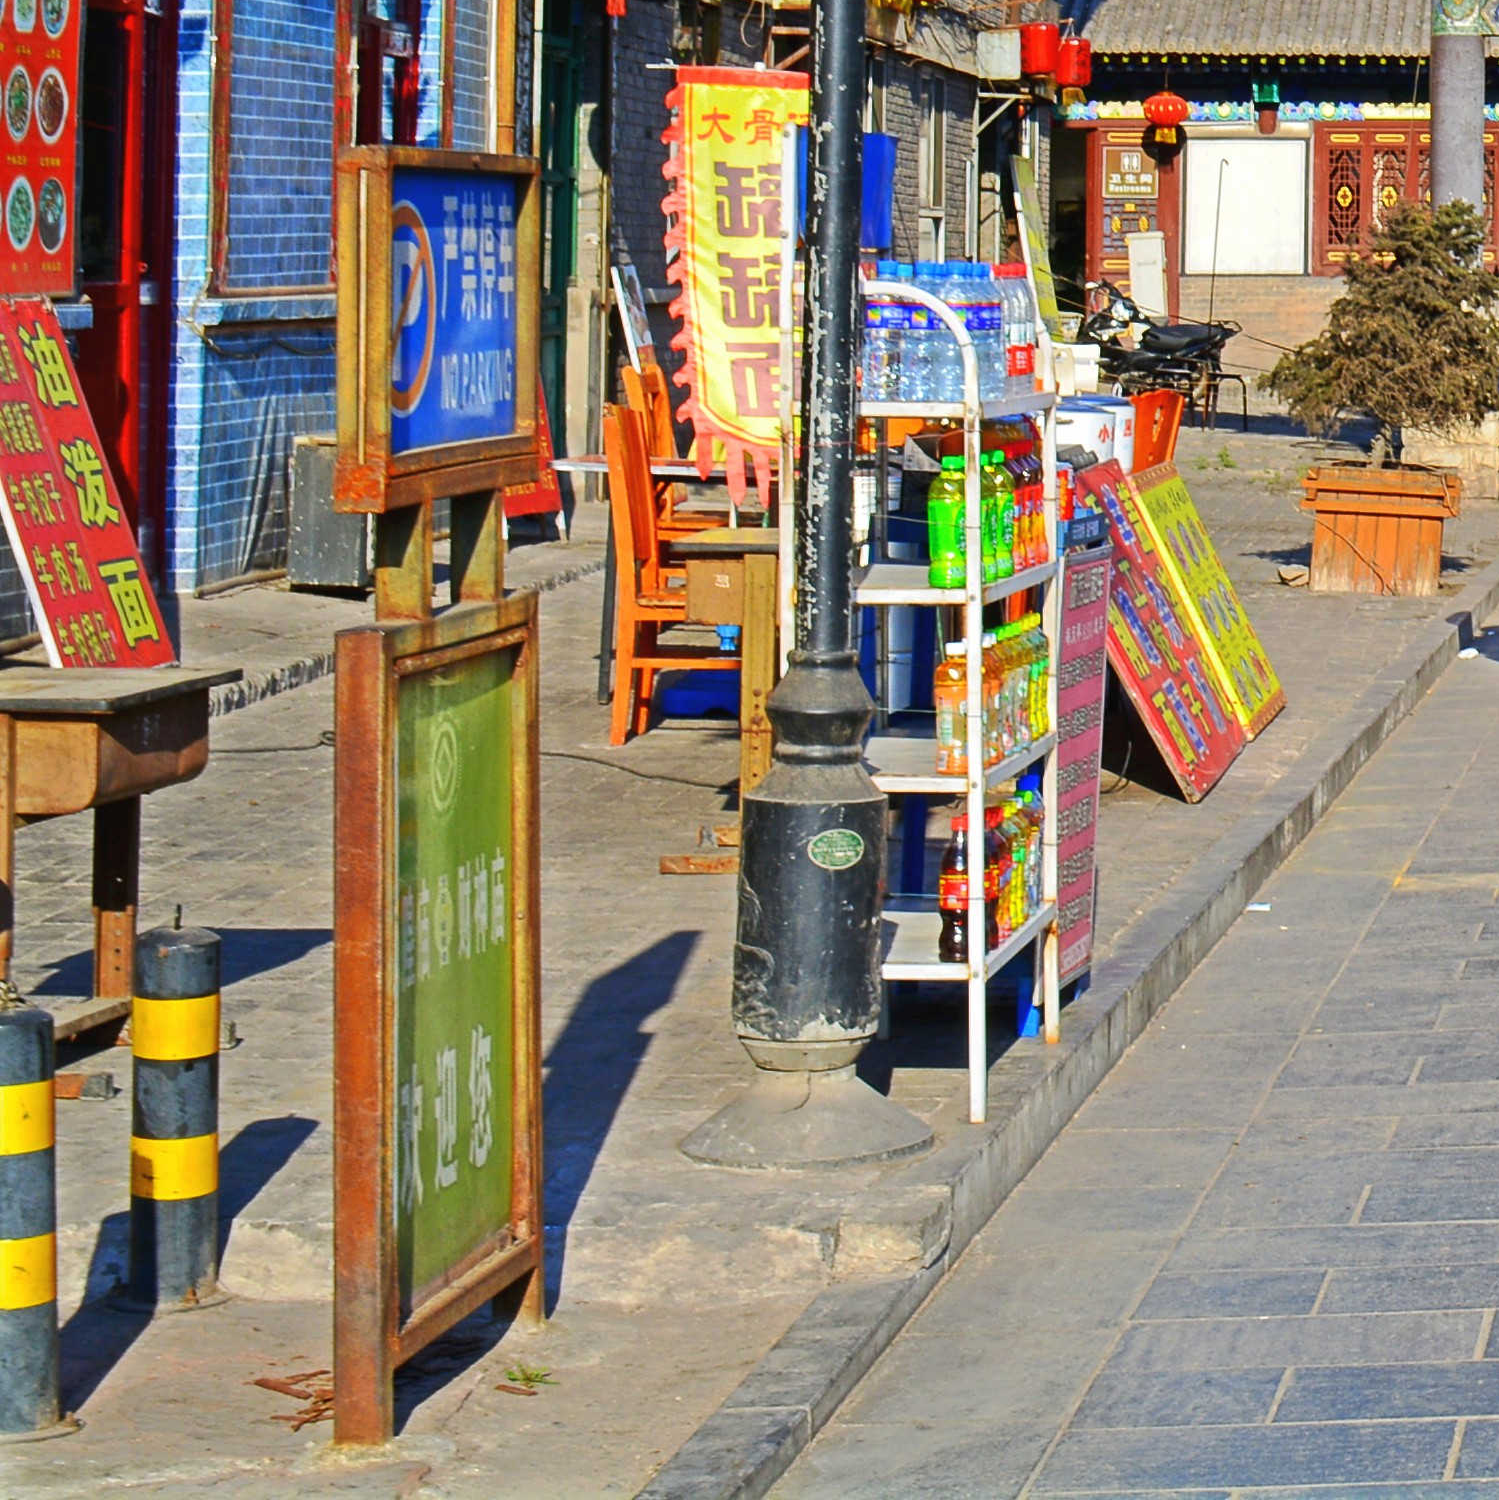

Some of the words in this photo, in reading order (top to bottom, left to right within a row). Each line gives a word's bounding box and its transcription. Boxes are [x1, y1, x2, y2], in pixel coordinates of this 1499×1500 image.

[697, 107, 808, 147] 大骨
[440, 189, 515, 323] 严禁停车
[440, 352, 460, 411] NO
[462, 347, 514, 406] PARKING
[16, 318, 161, 650] 油泼面
